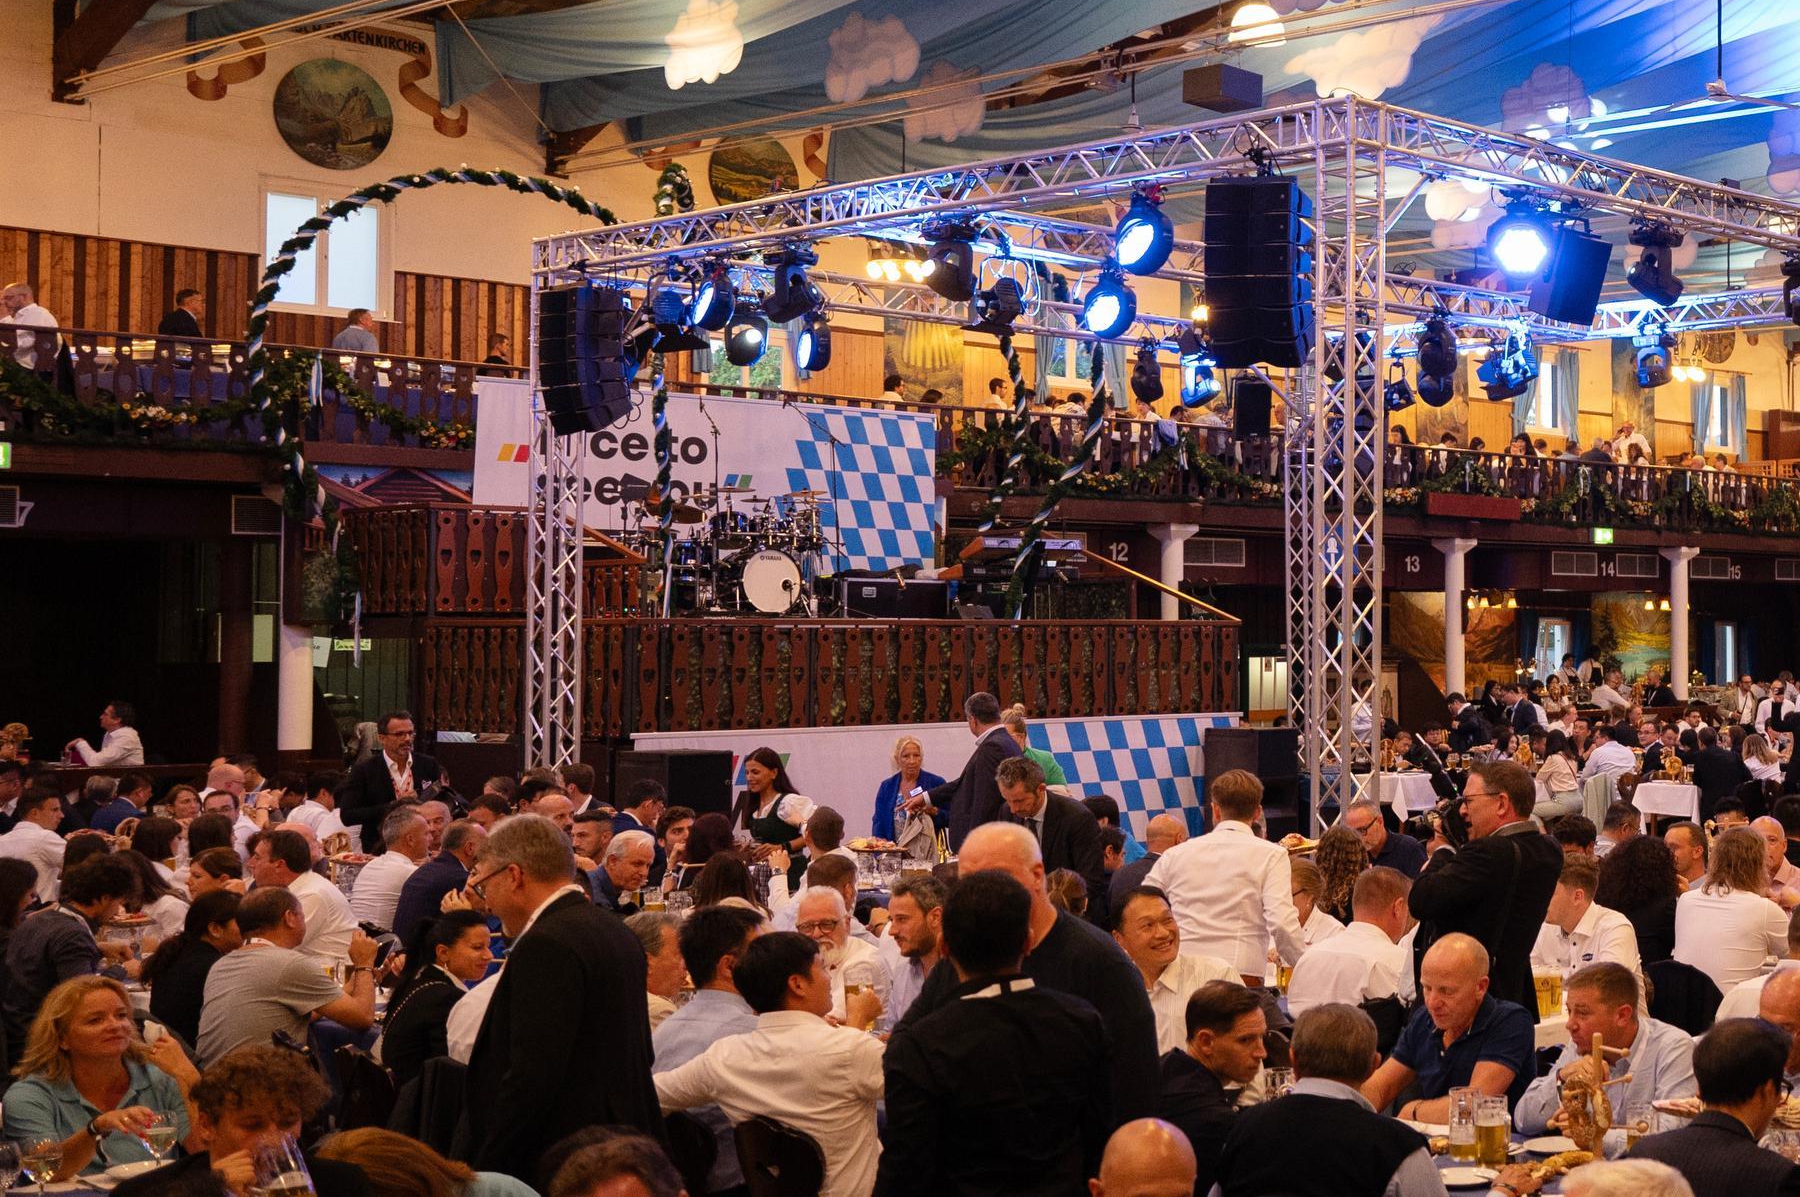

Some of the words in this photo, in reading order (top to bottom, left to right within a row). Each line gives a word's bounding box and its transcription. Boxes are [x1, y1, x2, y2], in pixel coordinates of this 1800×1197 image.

[539, 429, 649, 462] ce
[668, 428, 708, 465] to
[1108, 542, 1129, 561] 12
[1405, 555, 1421, 573] 13
[1600, 561, 1615, 578] 14
[1729, 565, 1741, 580] 15
